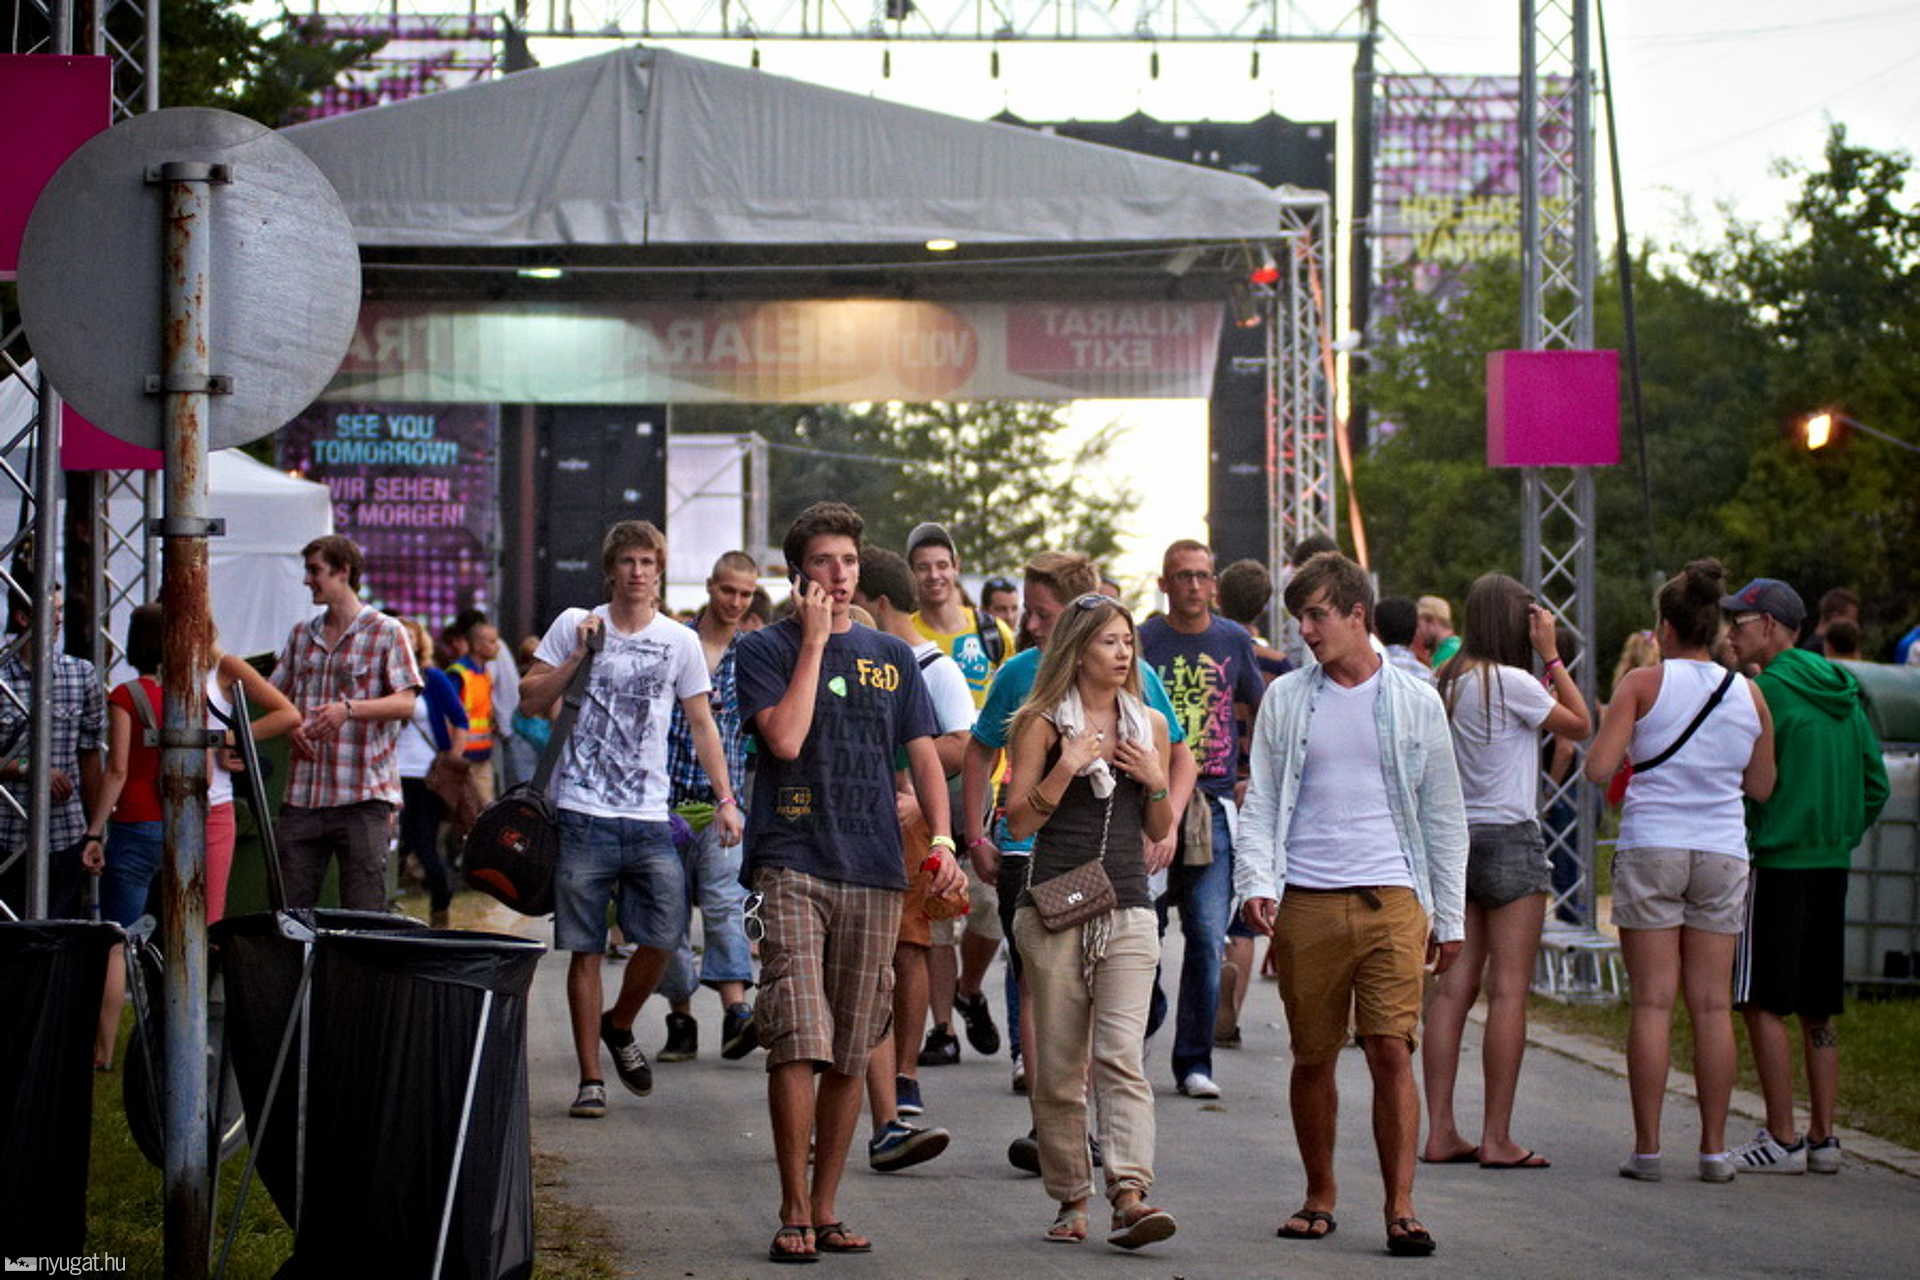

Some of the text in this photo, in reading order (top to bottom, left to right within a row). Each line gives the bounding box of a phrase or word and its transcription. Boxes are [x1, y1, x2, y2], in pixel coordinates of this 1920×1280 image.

[336, 414, 436, 439] SEE YOU
[312, 440, 459, 465] TOMORROW!
[321, 477, 450, 501] WIR SEHEN
[358, 503, 465, 527] MORGEN!
[856, 658, 900, 693] F&D
